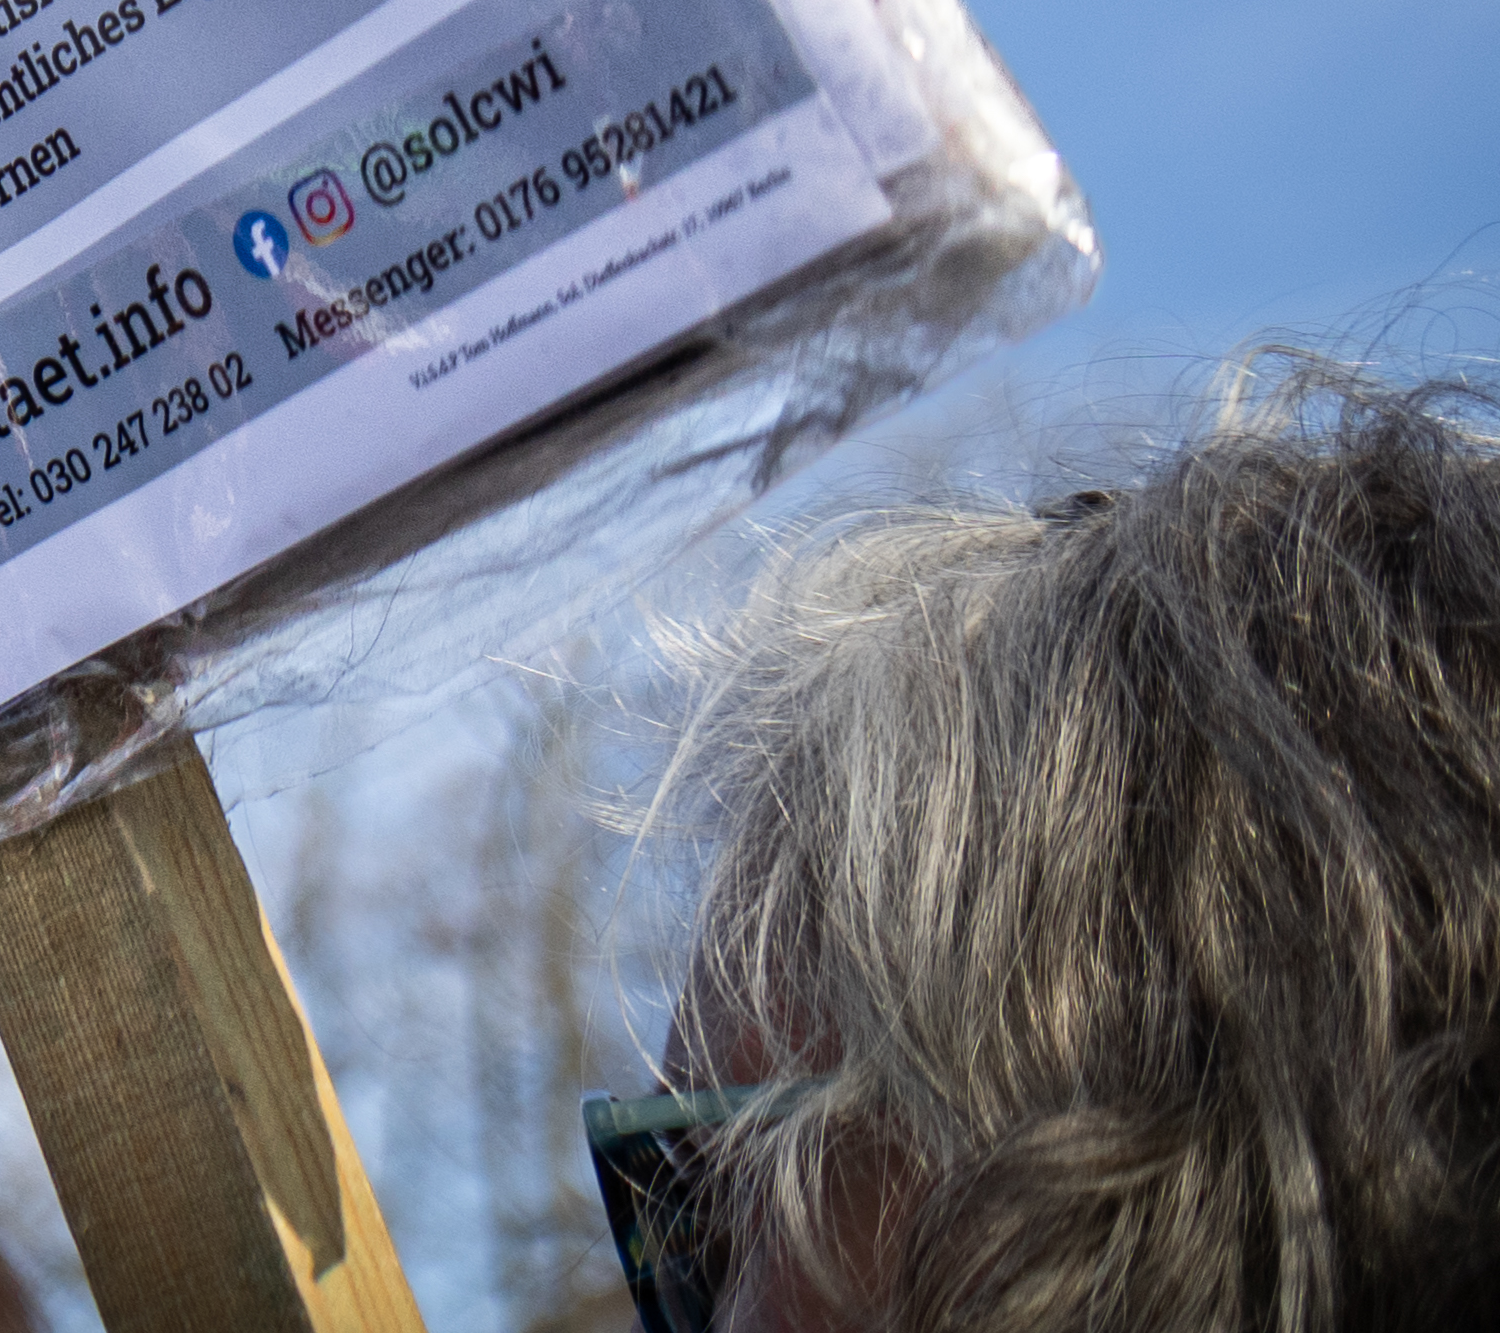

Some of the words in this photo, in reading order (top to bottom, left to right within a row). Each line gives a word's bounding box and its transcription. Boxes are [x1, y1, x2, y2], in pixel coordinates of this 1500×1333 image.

[360, 38, 565, 207] @solcwi
[29, 448, 91, 504] 030
[92, 410, 149, 470] 247
[152, 377, 209, 435] 238
[208, 352, 252, 399] 02
[274, 226, 474, 360] Messenger:
[474, 167, 560, 241] 0176
[561, 66, 736, 190] 95281421
